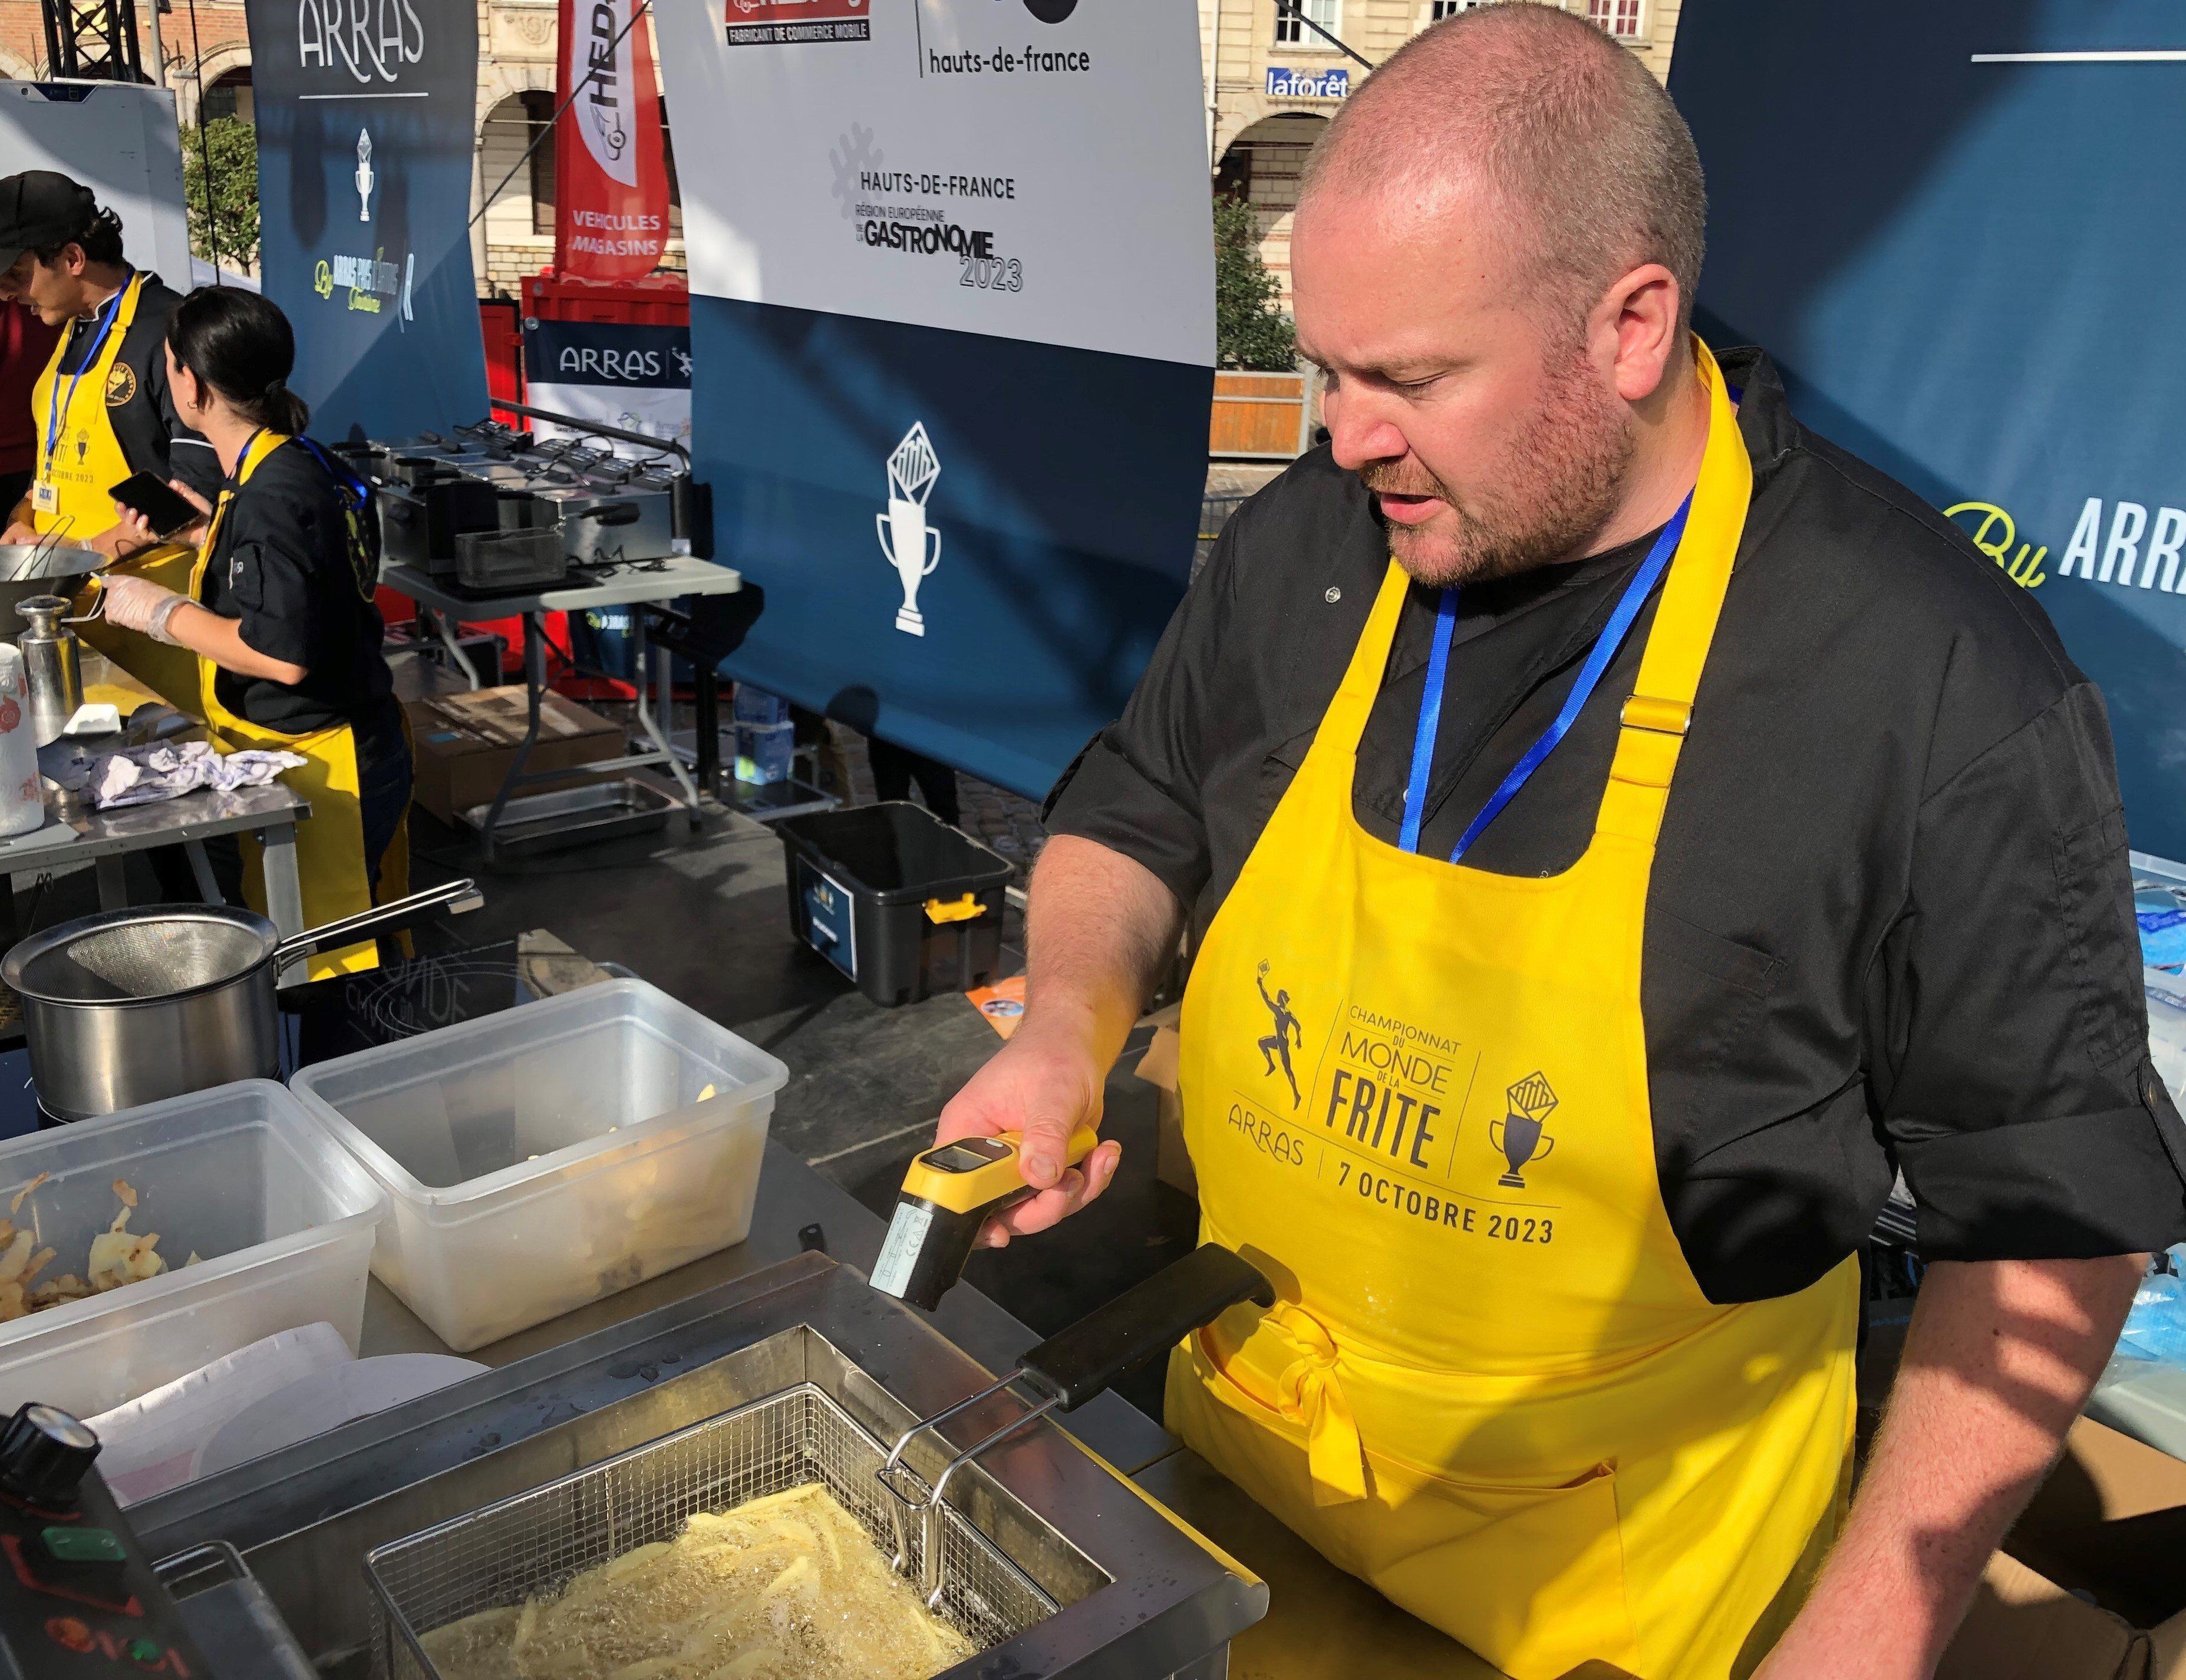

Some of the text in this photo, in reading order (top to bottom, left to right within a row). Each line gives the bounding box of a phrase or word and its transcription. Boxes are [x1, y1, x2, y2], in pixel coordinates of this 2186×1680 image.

[299, 0, 424, 83] ARRAS
[588, 0, 617, 108] HED
[929, 45, 1090, 73] hauts-de-france
[1267, 71, 1348, 98] laforêt
[860, 171, 1015, 199] HAUTS-DE-FRANCE
[572, 235, 660, 256] MAGASINS
[960, 255, 1023, 293] 2023
[560, 346, 661, 381] ARRAS
[2058, 497, 2186, 595] ARR
[1350, 1005, 1462, 1055] CHAMPIONNAT
[1392, 1035, 1405, 1048] DU
[1340, 1031, 1452, 1094] MONDE
[1376, 1070, 1400, 1089] DE LA
[1326, 1068, 1440, 1169] FRITE
[1229, 1104, 1553, 1245] ARRAS 7 OCTOBRE 2023
